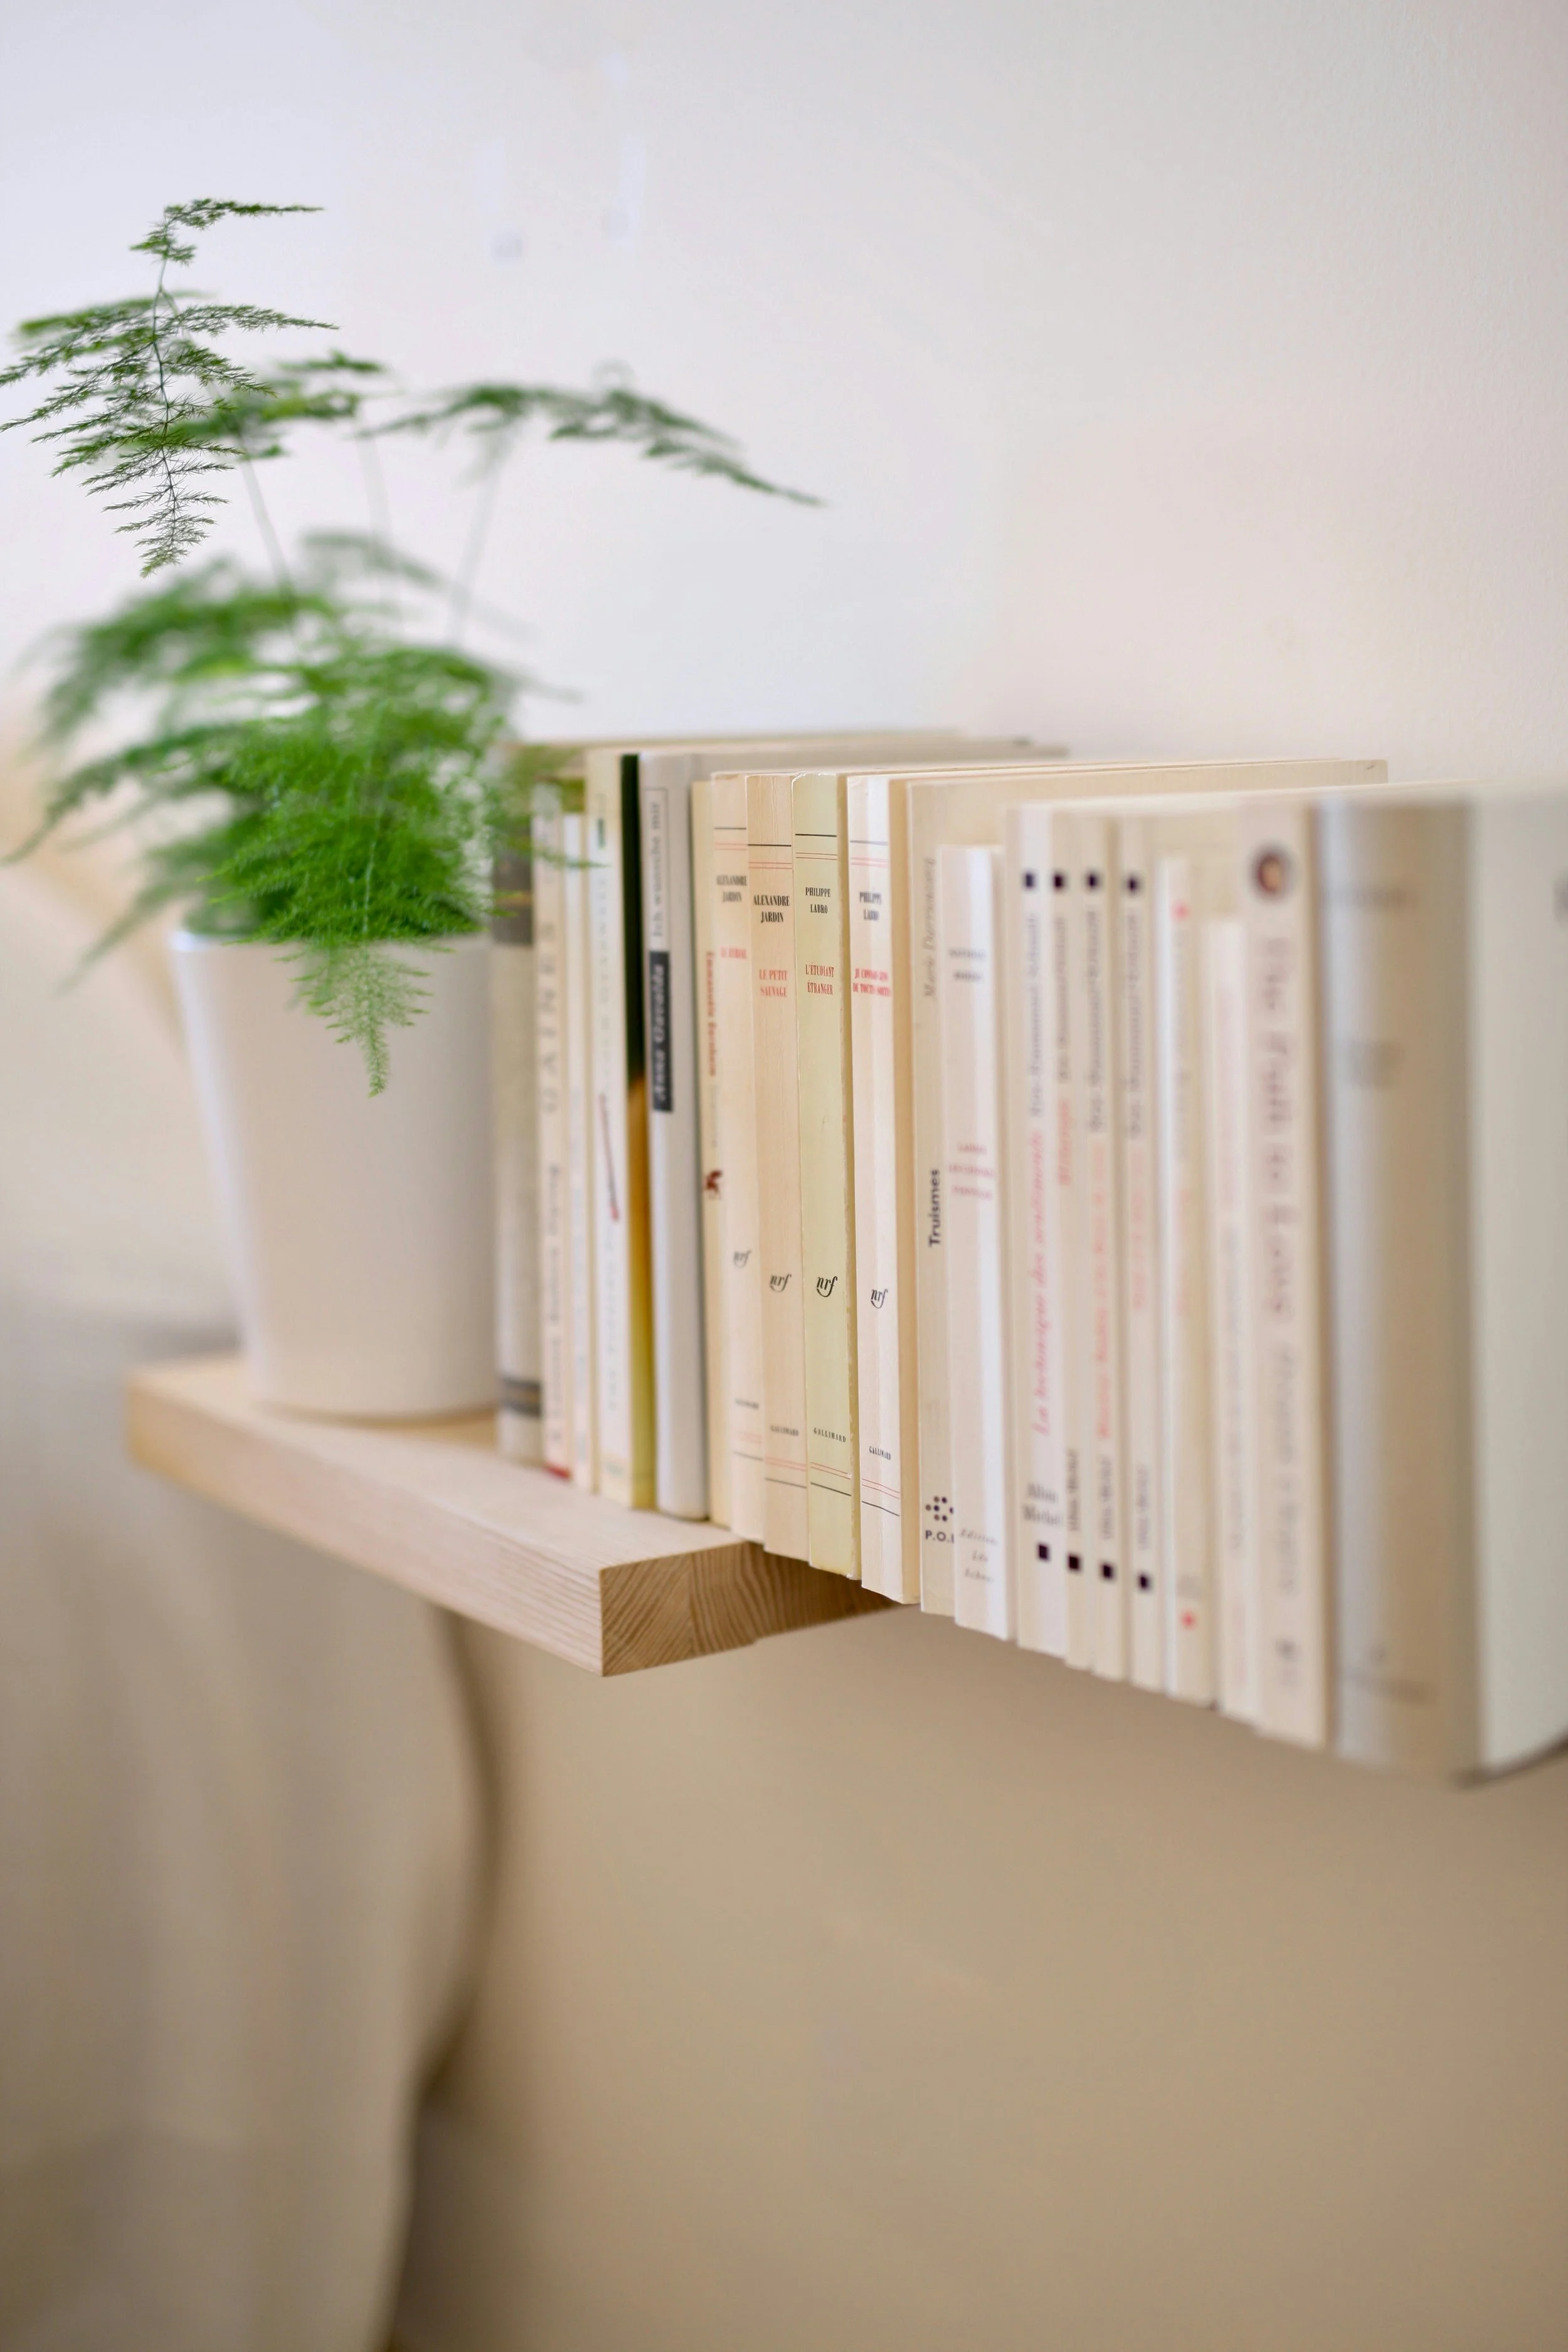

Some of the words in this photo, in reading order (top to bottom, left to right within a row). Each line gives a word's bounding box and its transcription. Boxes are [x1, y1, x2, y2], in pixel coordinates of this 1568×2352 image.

[717, 875, 748, 886] ALEXANDRE
[723, 891, 742, 903] JARDIN
[805, 887, 831, 898] PHILIPPE
[753, 894, 790, 907] ALEXANDRE
[810, 904, 828, 914] LABRO
[761, 911, 784, 923] JARDIN
[759, 969, 767, 980] LE
[769, 970, 788, 981] PETIT
[805, 963, 835, 978] L'ÉTUDIANT
[760, 986, 788, 998] SAUVAGE
[807, 980, 834, 995] ÉTRANGER
[853, 983, 859, 992] DE
[928, 1168, 941, 1247] Truismes
[734, 1250, 752, 1268] nrf
[770, 1274, 792, 1293] nrf
[817, 1276, 838, 1298] nrf
[871, 1288, 888, 1309] nrf
[813, 1428, 846, 1443] GALLIMARD
[869, 1445, 891, 1460] GALLIMARD
